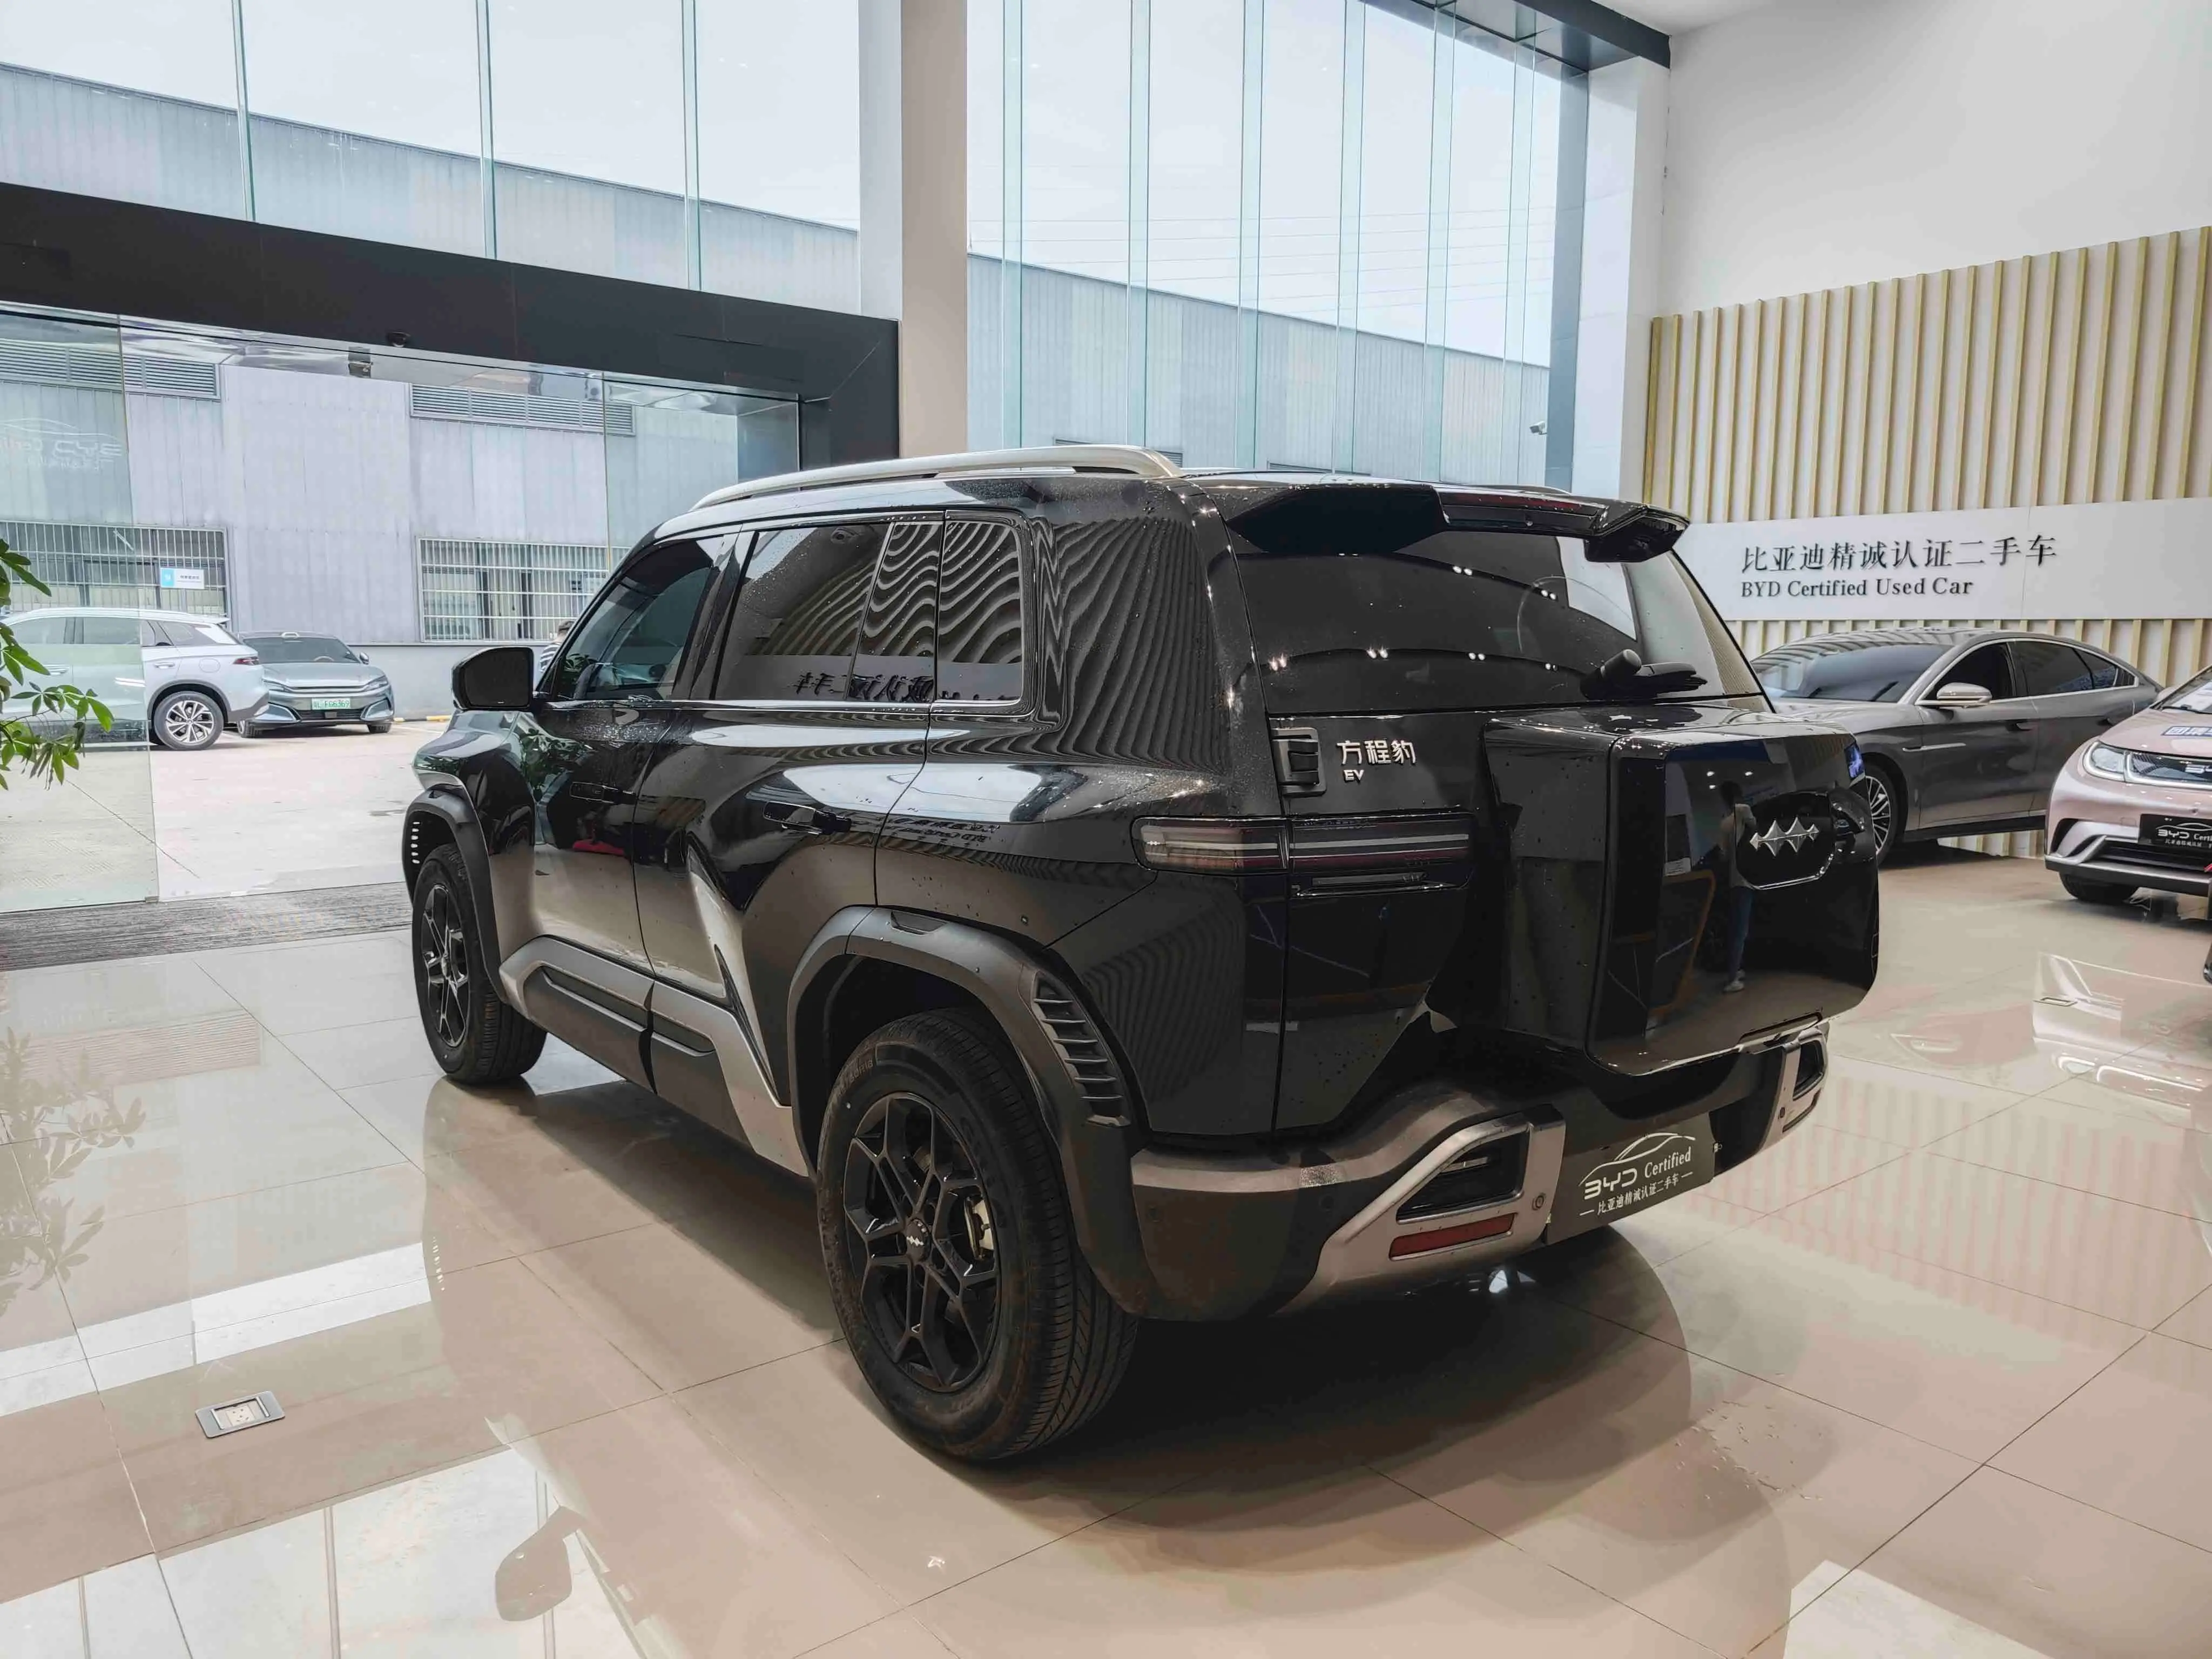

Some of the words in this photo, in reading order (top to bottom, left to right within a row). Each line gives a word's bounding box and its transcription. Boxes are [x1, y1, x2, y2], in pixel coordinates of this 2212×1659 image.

[1741, 535, 2056, 573] 比亚迪精诚认证二手车
[1741, 581, 1781, 597] BYD
[1788, 579, 1867, 597] Certified
[1876, 578, 1925, 595] Used
[1932, 577, 1974, 595] Car
[1337, 740, 1416, 765] 方程豹
[1343, 769, 1365, 781] EV
[2157, 828, 2190, 839] BYD
[1584, 1168, 1637, 1200] BYD
[1644, 1146, 1692, 1178] Certified
[1597, 1174, 1680, 1215] 比亚迪精诚认证二手车
